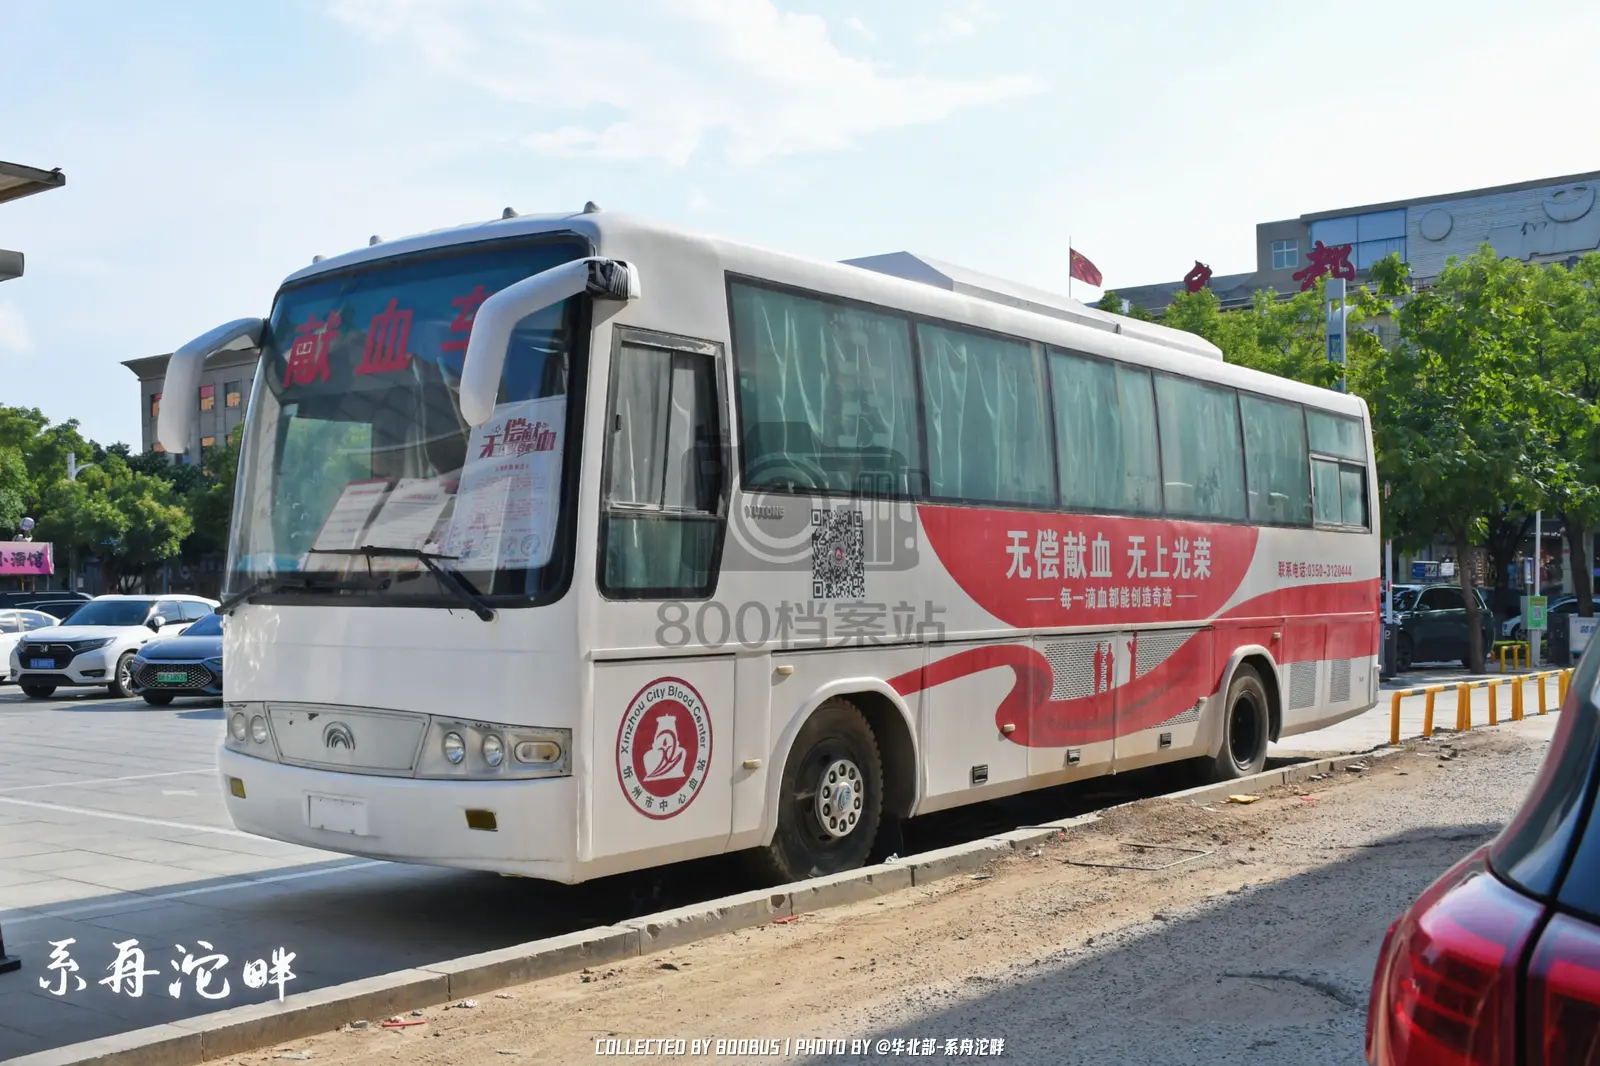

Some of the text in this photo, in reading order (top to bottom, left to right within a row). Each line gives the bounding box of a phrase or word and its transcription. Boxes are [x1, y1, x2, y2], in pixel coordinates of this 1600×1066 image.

[479, 417, 557, 459] 无偿献血
[1005, 529, 1212, 580] 无偿献血 无上光荣
[1060, 587, 1172, 610] 每一滴血都能创造奇迹
[621, 685, 707, 754] Xinzhou City Blood Center
[623, 759, 707, 812] 忻州市中心血站
